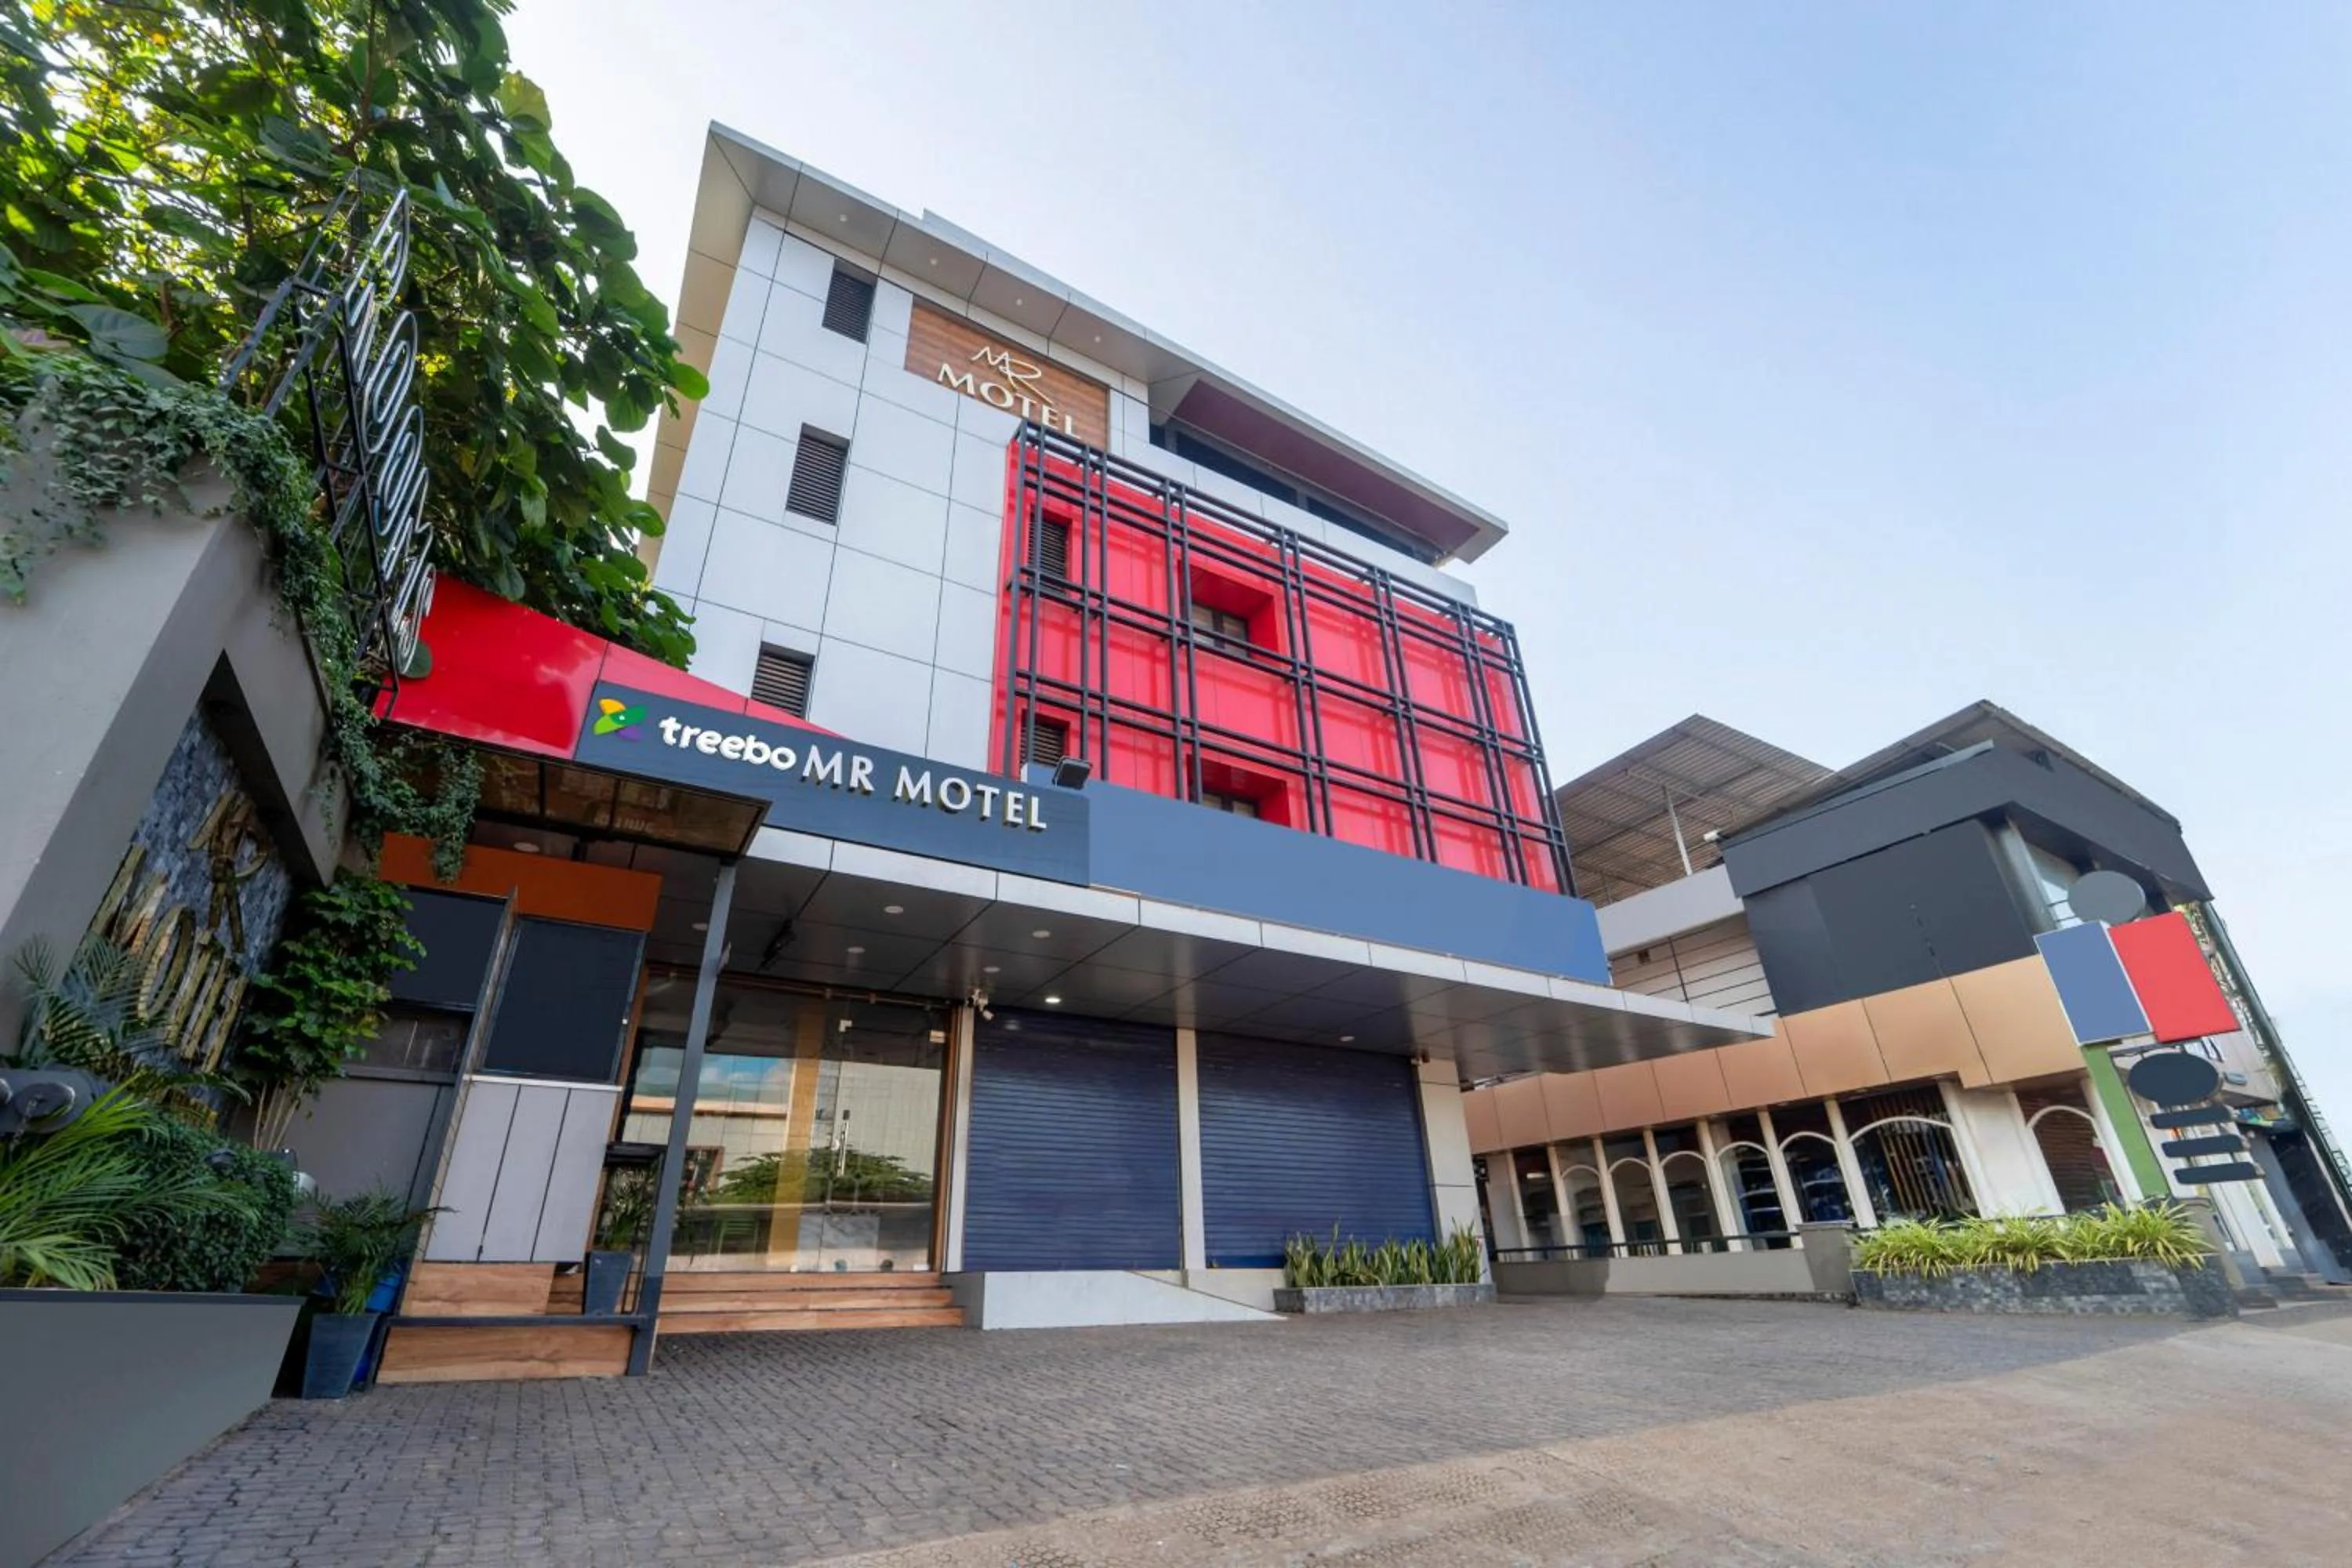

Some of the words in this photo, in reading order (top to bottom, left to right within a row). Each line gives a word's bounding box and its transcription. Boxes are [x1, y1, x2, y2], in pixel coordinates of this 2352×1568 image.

[345, 188, 437, 676] ROOMS
[938, 363, 1081, 440] MOTEL
[659, 716, 797, 771] treebo
[801, 744, 875, 792] MR
[895, 765, 1047, 829] MOTEL
